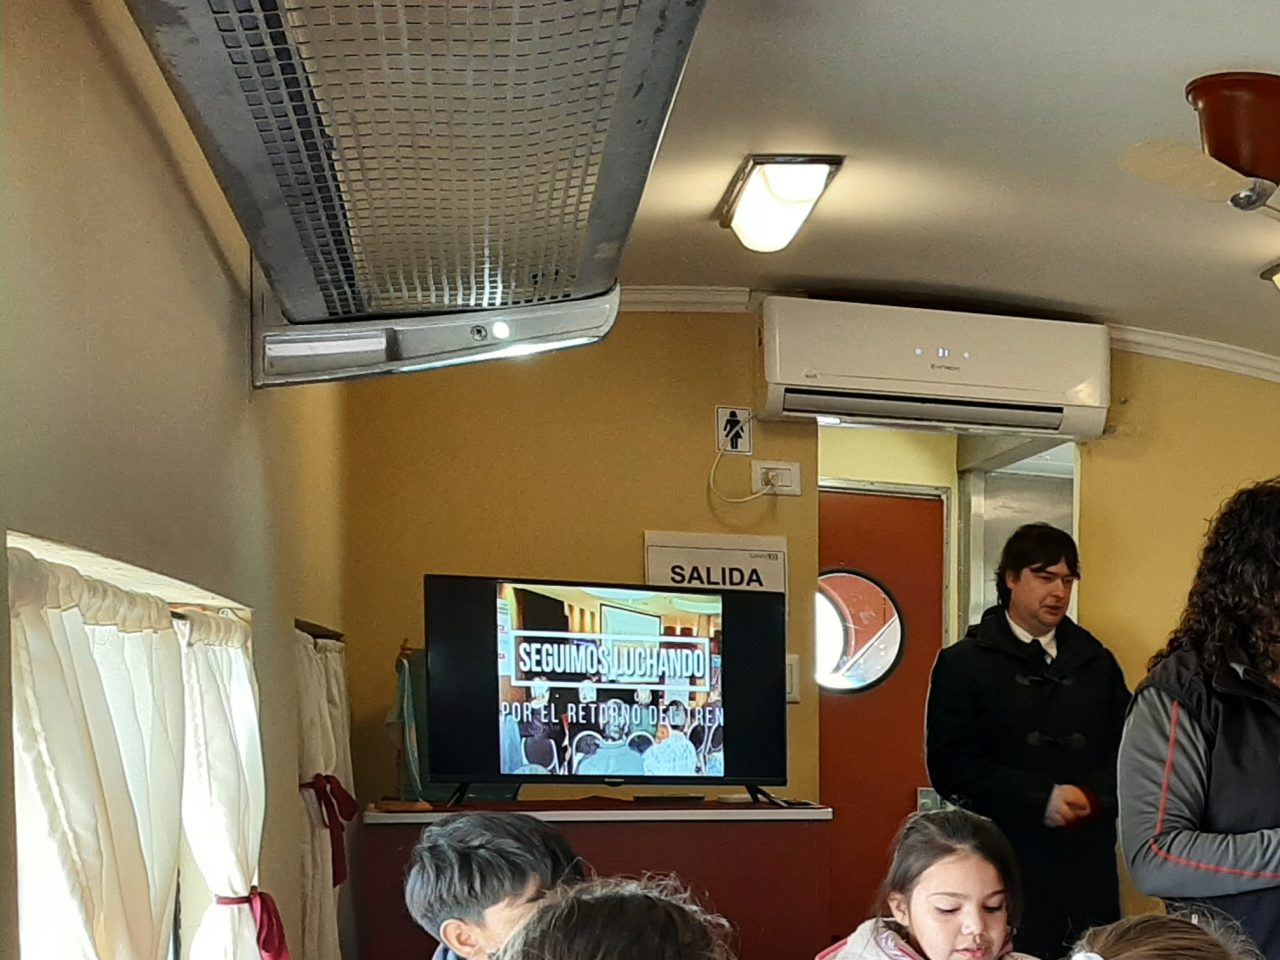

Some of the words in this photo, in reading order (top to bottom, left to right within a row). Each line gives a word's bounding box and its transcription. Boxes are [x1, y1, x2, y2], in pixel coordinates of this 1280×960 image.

[670, 565, 764, 587] SALIDA
[518, 642, 610, 675] SEGUIMOS
[614, 646, 705, 679] LUCHANDO
[502, 702, 533, 723] POR
[541, 703, 559, 723] EL
[568, 703, 641, 726] RETORNO
[650, 705, 678, 726] DEL
[687, 706, 724, 727] TREN
